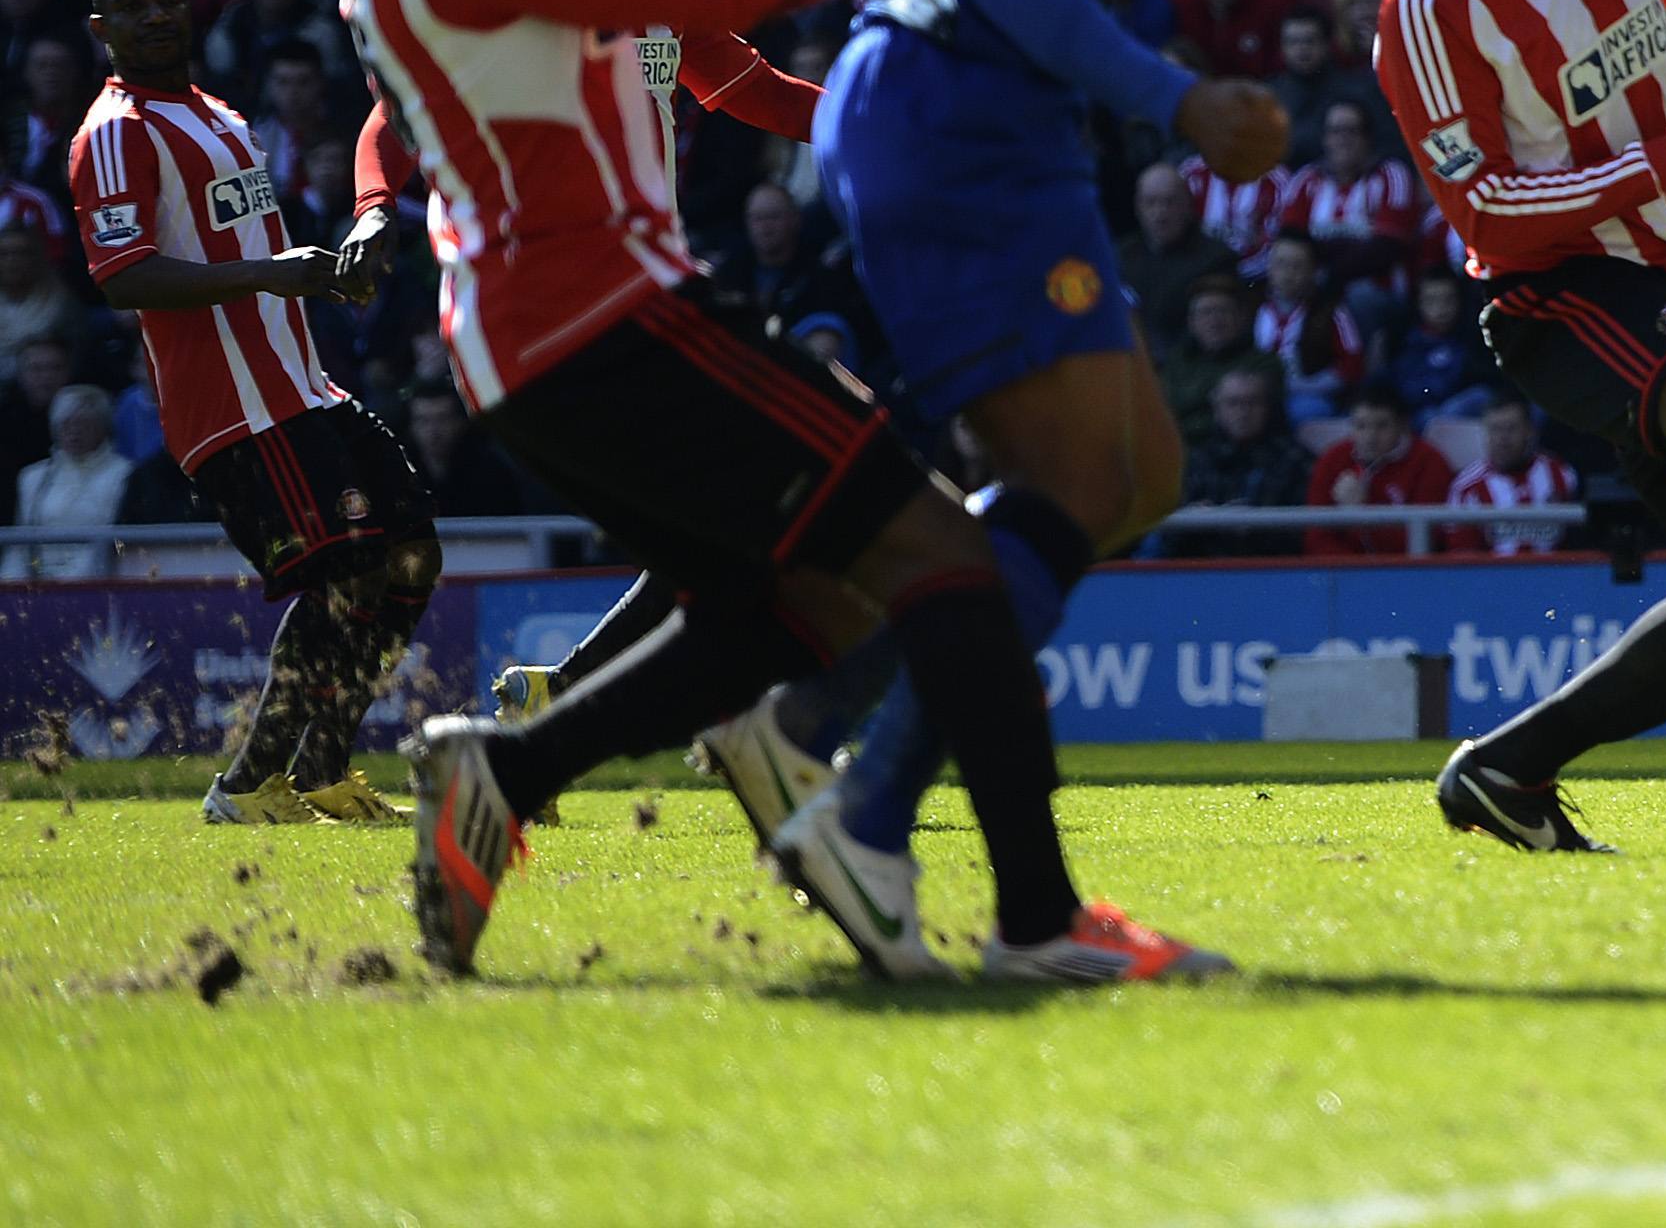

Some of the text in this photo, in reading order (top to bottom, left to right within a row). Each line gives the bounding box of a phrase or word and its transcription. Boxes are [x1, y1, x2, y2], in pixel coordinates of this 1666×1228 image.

[1600, 5, 1653, 58] INVEST
[638, 61, 675, 85] RICA
[1176, 640, 1280, 708] us
